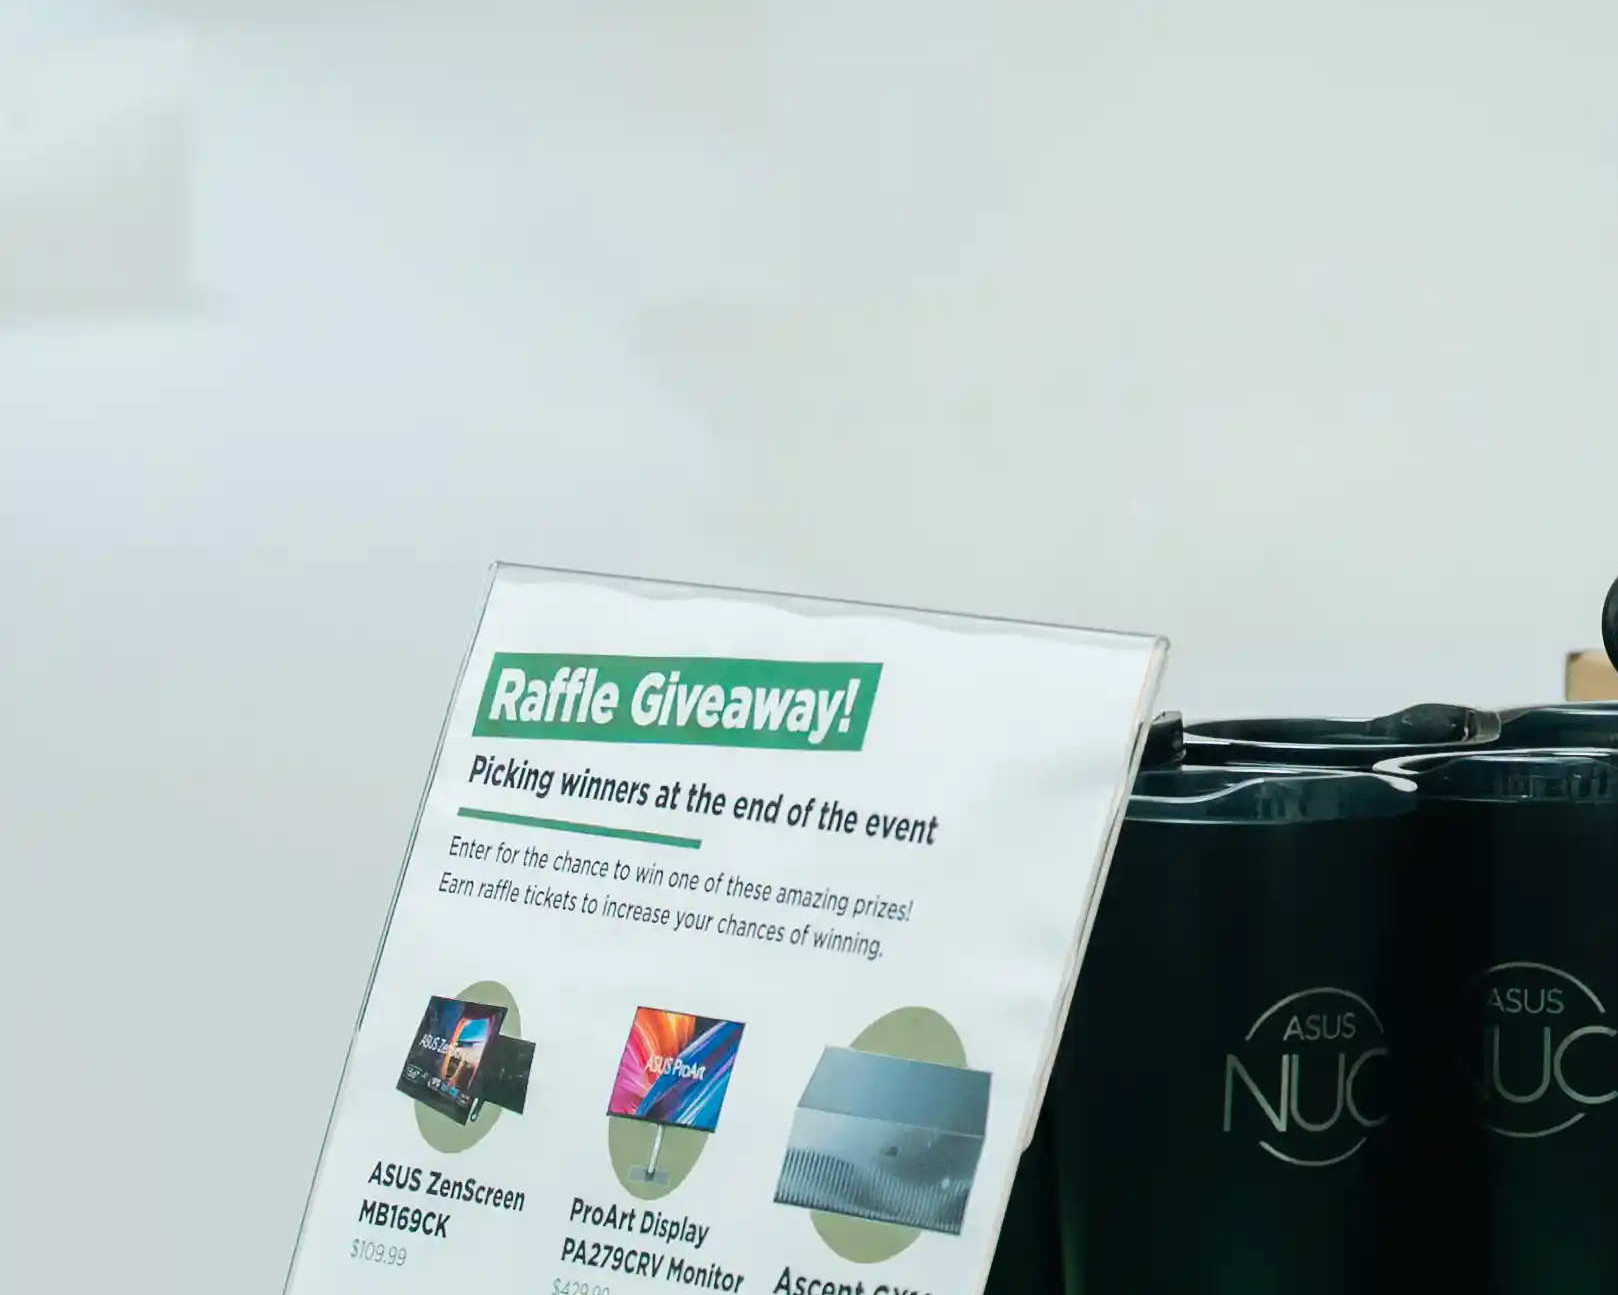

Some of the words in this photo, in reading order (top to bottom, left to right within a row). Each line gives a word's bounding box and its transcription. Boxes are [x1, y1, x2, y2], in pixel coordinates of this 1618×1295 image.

[488, 666, 620, 724] Raffle
[630, 670, 862, 745] Giveaway!
[468, 754, 555, 799] Picking
[560, 768, 651, 806] winners
[654, 781, 682, 810] at
[686, 782, 726, 816] the
[733, 793, 784, 824] end
[787, 797, 816, 828] of
[818, 800, 858, 834] the
[865, 813, 938, 845] event
[449, 835, 493, 861] Enter
[495, 841, 521, 864] for
[523, 846, 549, 869] the
[553, 850, 609, 878] chance
[613, 859, 631, 881] to
[636, 866, 664, 886] win
[668, 871, 700, 891] one
[703, 872, 725, 894] of
[726, 875, 772, 902] these
[775, 886, 850, 917] amazing
[852, 898, 914, 922] prizes!
[438, 871, 474, 896] Earn
[477, 878, 520, 903] raffle
[523, 885, 578, 912] tickets
[581, 893, 598, 915] to
[602, 900, 671, 926] increase
[673, 910, 714, 932] your
[717, 913, 786, 943] chances
[789, 923, 811, 946] of
[813, 927, 883, 962] winning.
[1283, 1012, 1356, 1041] ASUS
[1482, 1024, 1618, 1104] UC
[367, 1161, 423, 1192] ASUS
[425, 1170, 525, 1212] ZenScreen
[358, 1199, 451, 1239] MB169CK
[569, 1197, 636, 1232] ProArt
[639, 1210, 710, 1250] Display
[349, 1238, 407, 1267] $109.99
[560, 1237, 665, 1278] PA279CRV
[666, 1256, 745, 1294] Monitor
